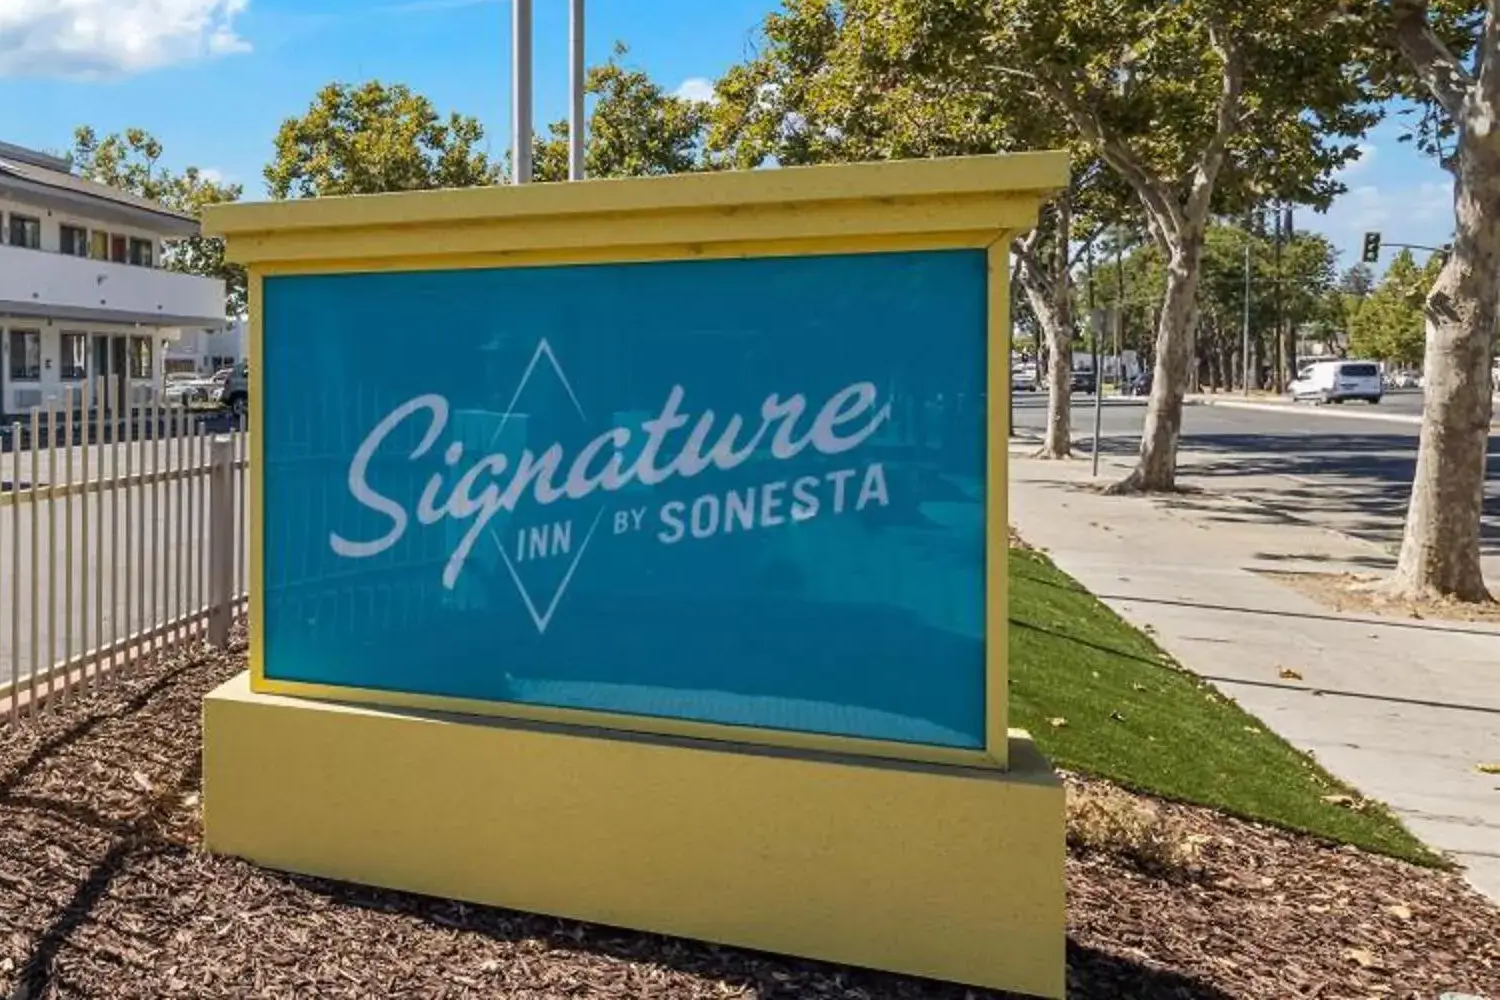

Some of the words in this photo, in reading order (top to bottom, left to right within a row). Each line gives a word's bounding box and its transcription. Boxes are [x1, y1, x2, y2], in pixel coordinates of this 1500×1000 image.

[330, 381, 892, 589] Signature
[613, 507, 647, 534] BY
[657, 463, 890, 544] SONESTA
[516, 520, 572, 562] INN
